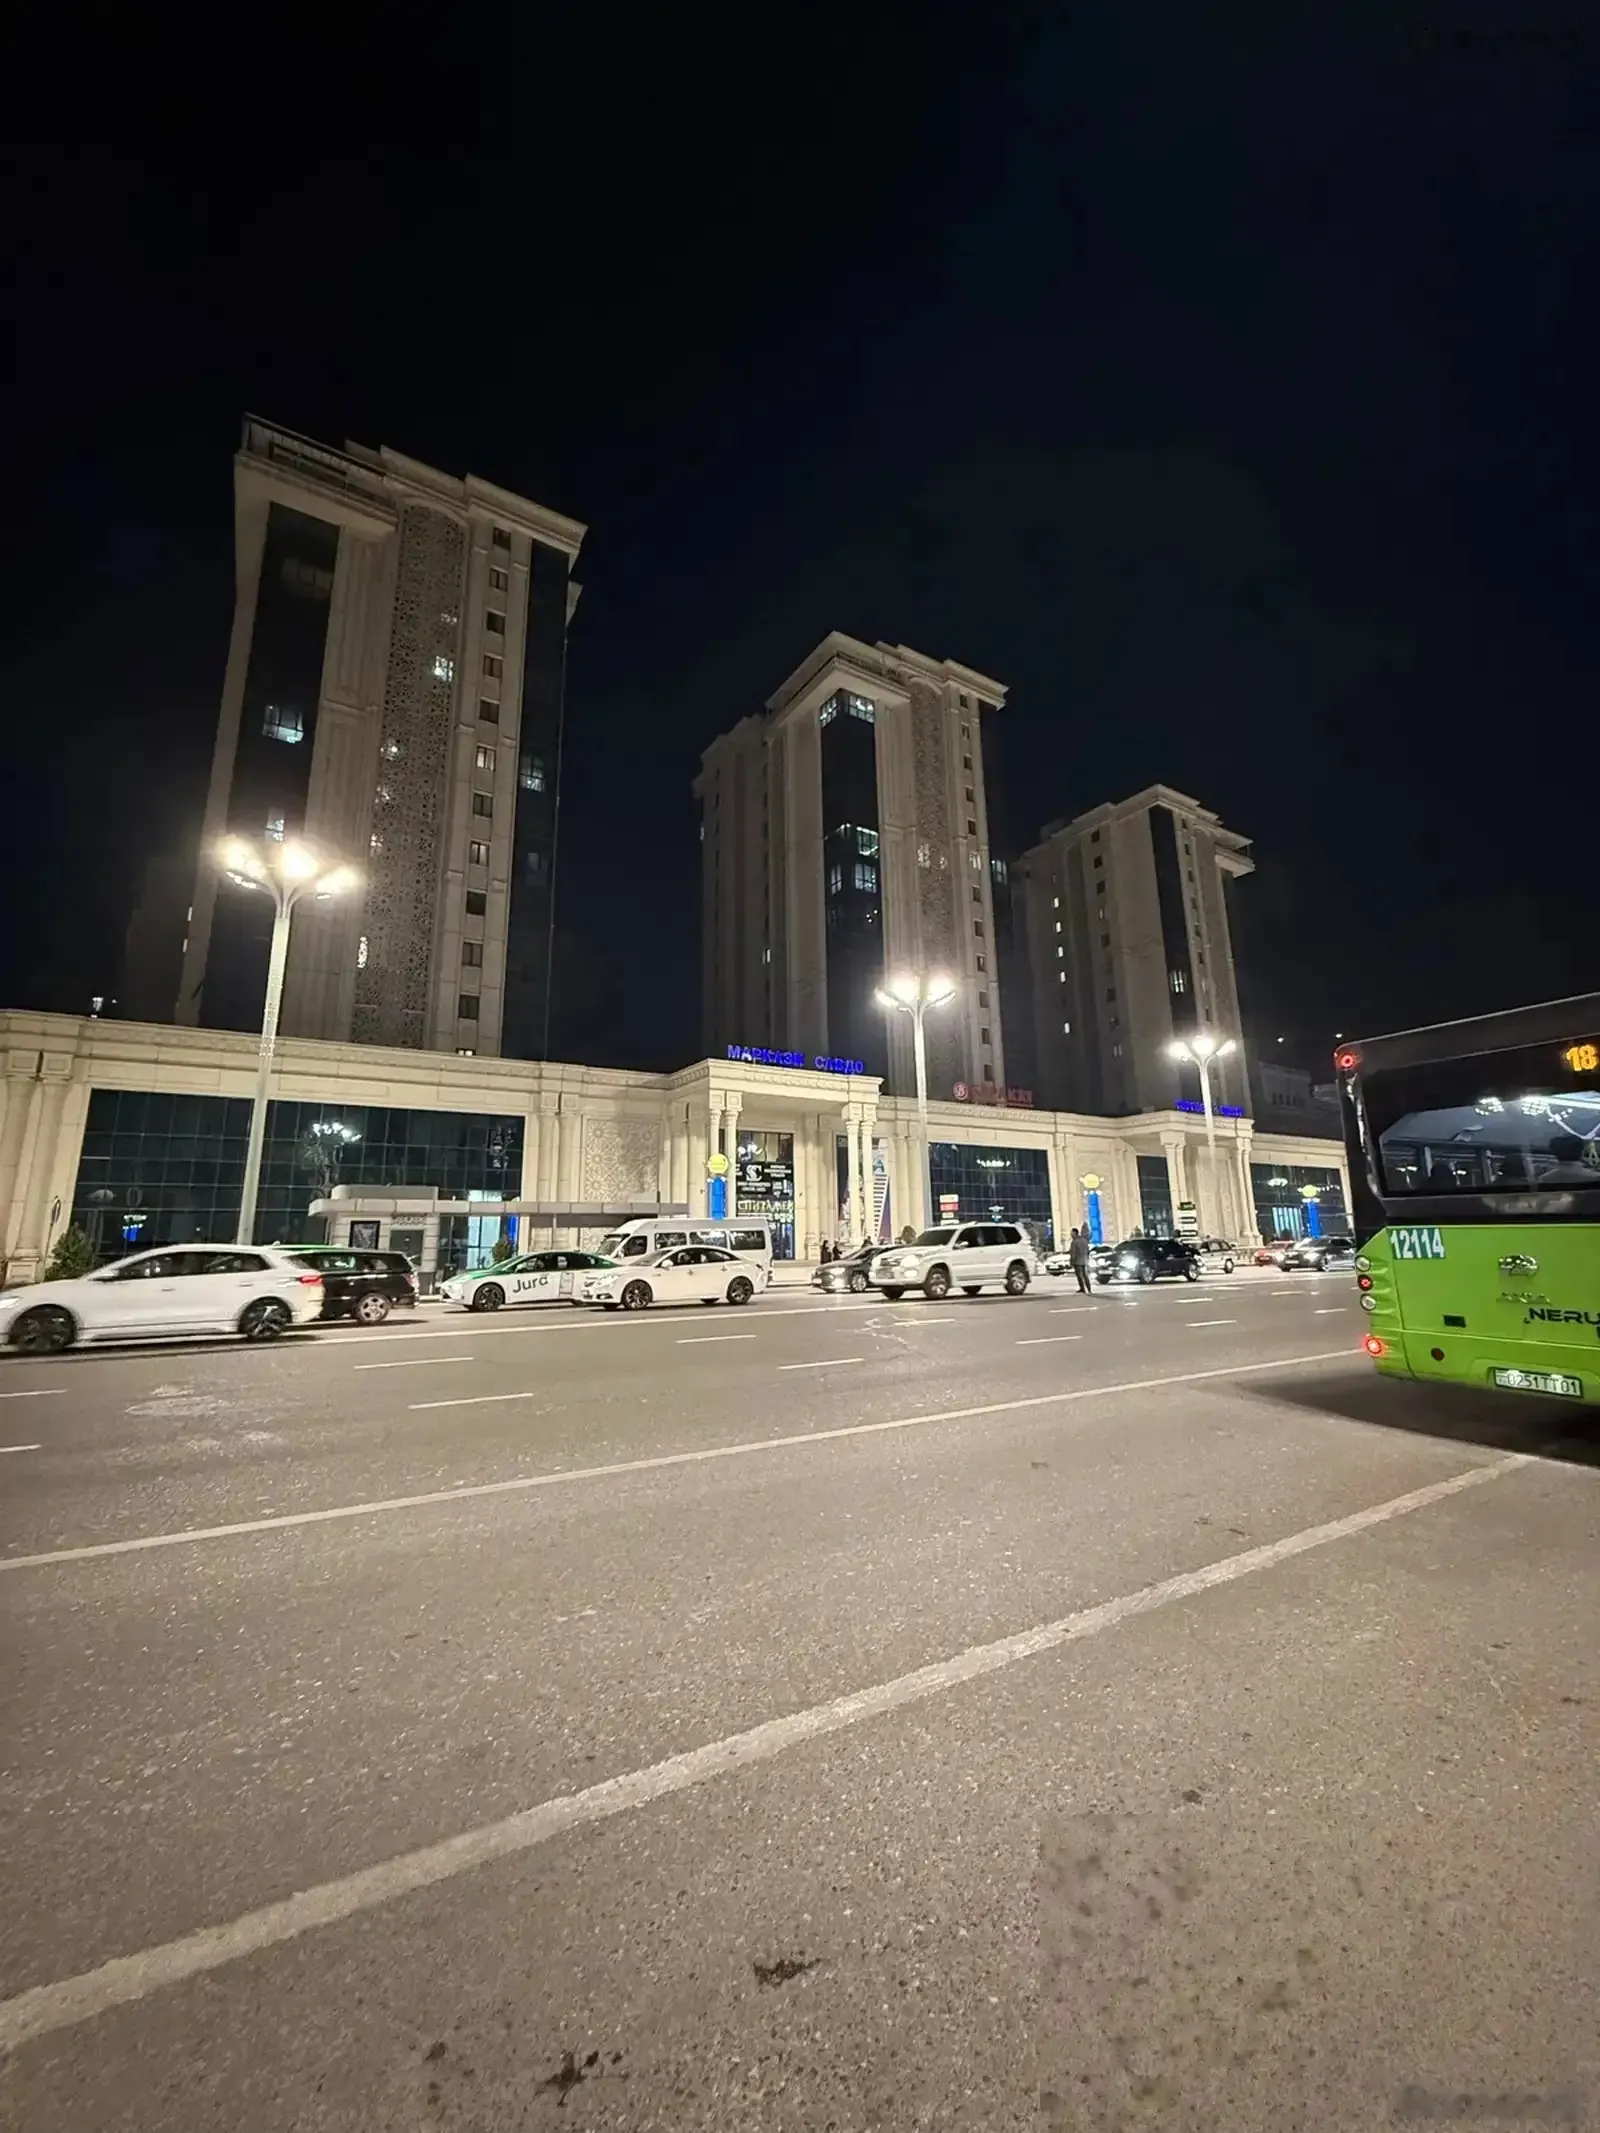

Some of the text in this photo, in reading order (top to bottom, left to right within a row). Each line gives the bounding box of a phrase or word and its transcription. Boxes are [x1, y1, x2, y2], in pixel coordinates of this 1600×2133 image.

[1566, 1045, 1597, 1071] 18
[1390, 1228, 1445, 1259] 12114
[512, 1276, 549, 1293] Jura
